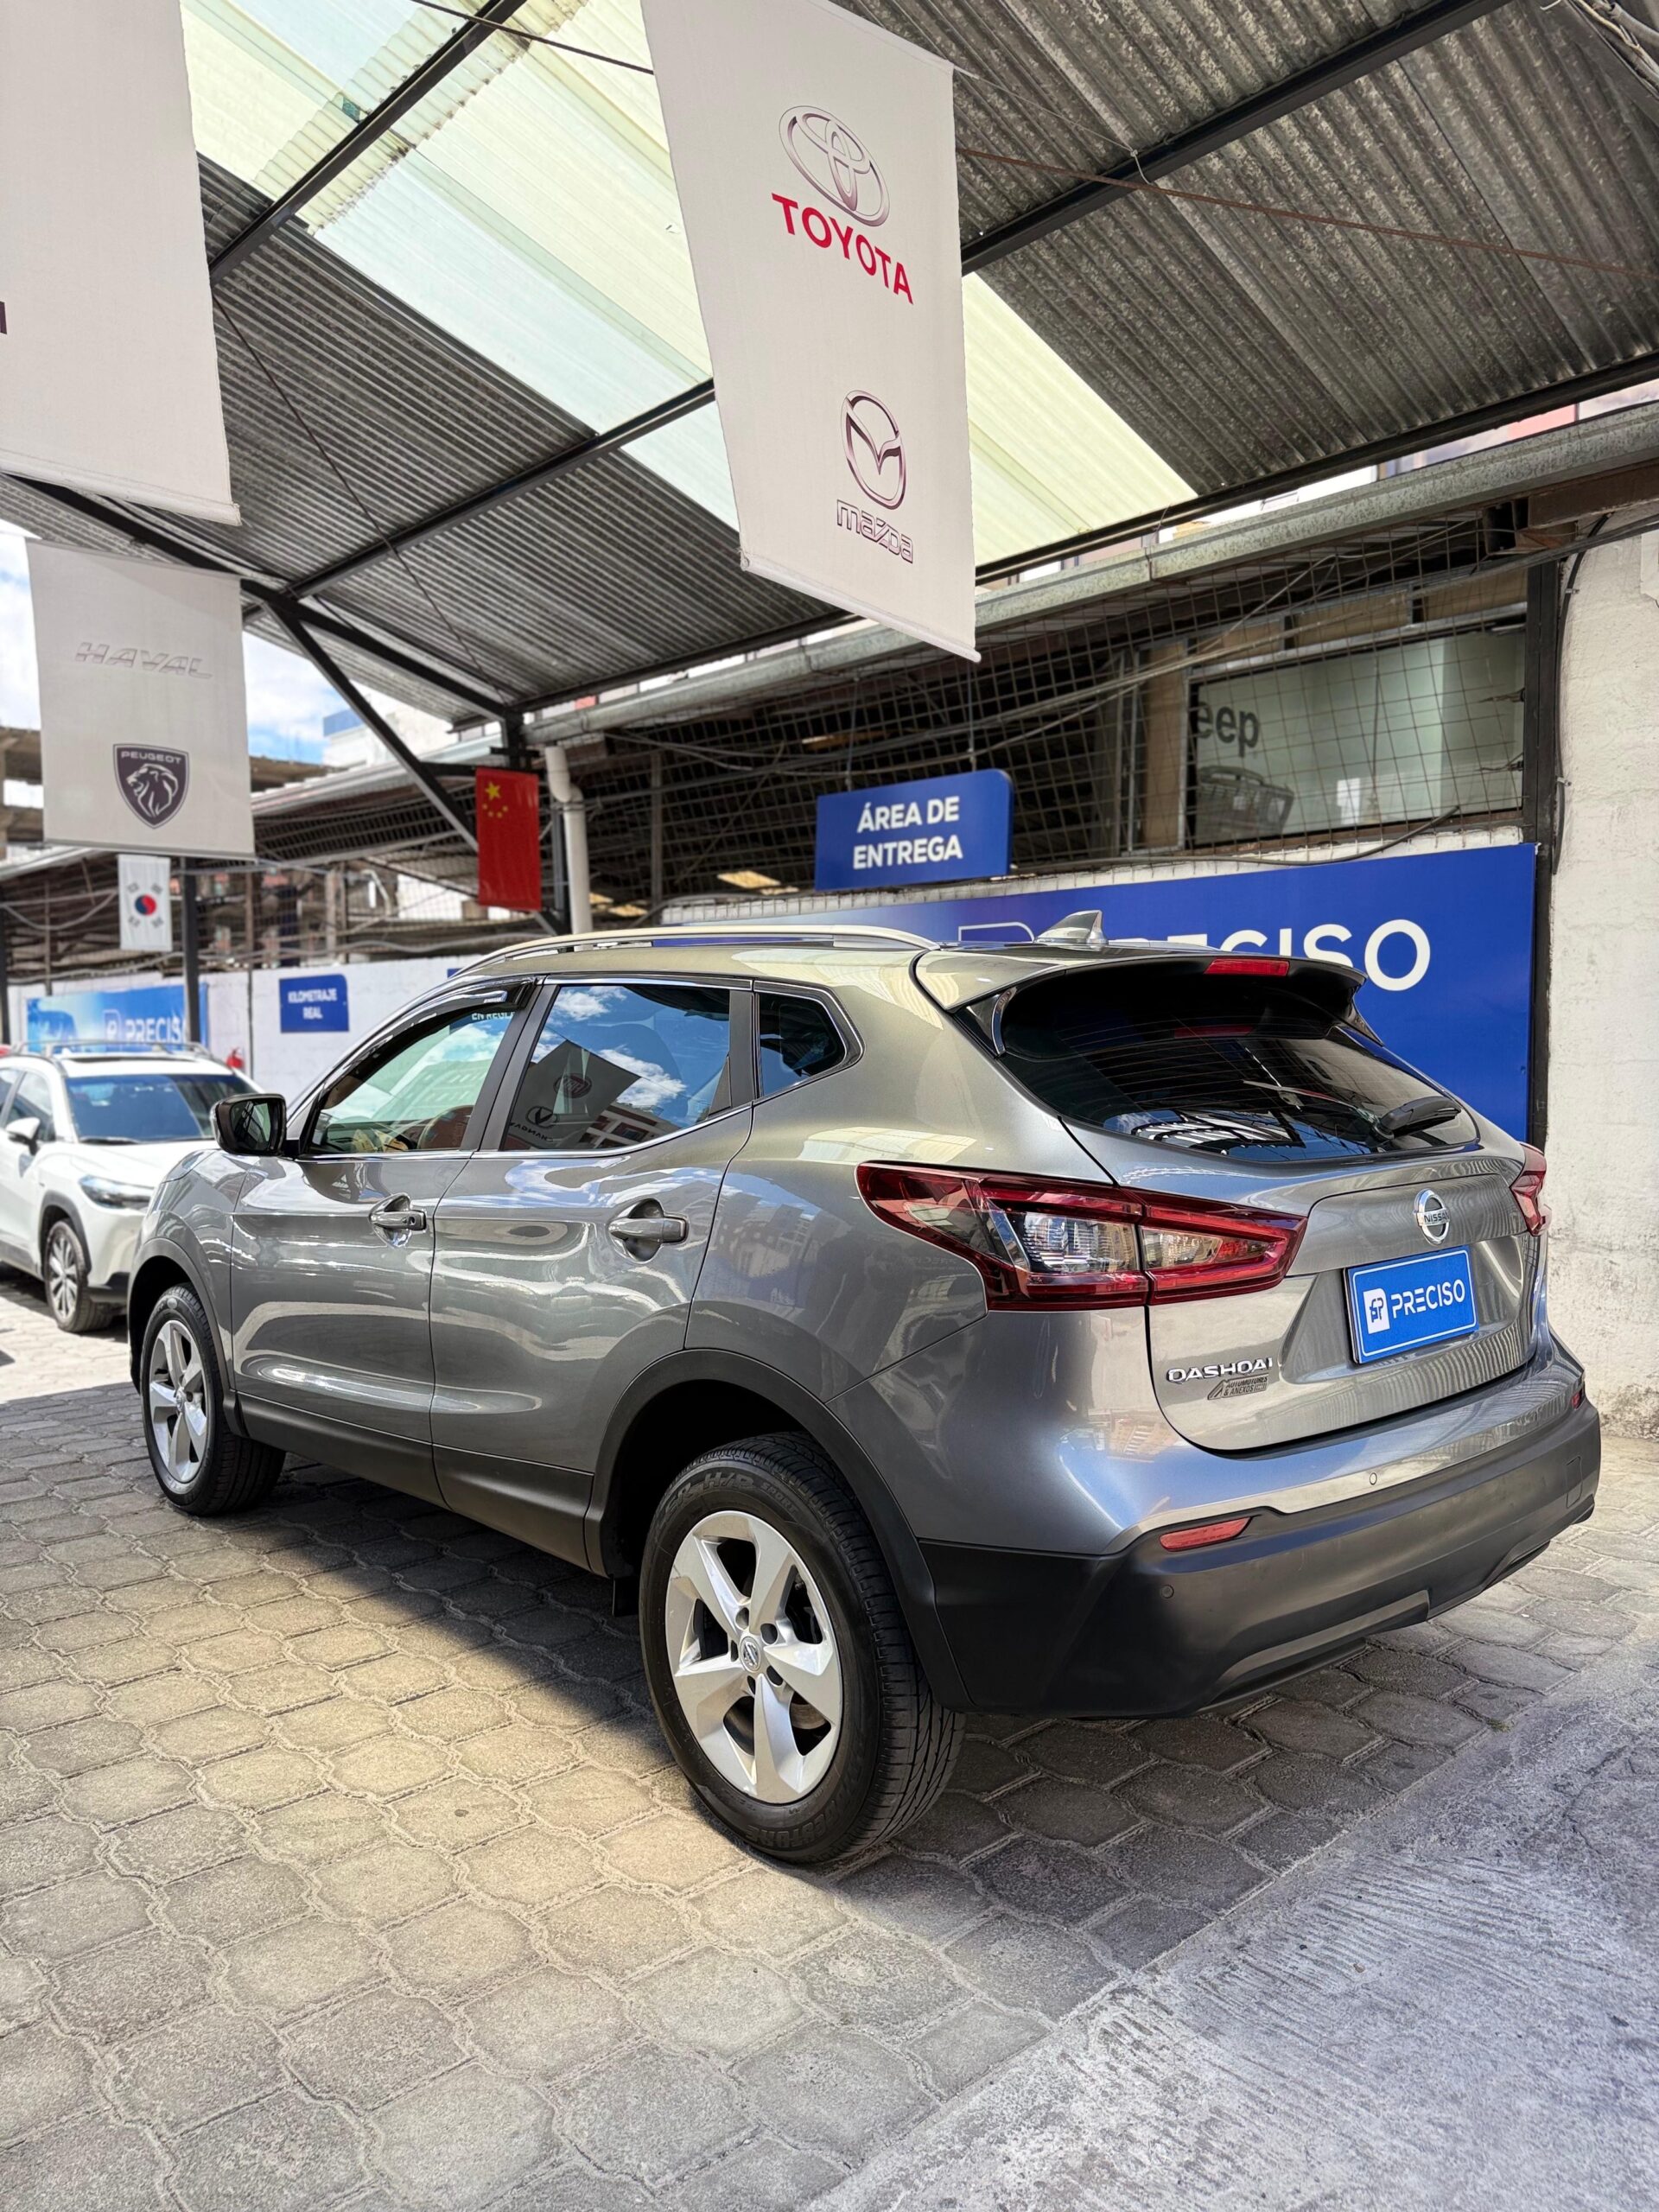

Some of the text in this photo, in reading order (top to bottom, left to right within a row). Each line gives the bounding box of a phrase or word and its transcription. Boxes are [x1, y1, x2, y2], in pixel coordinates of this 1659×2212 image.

[771, 193, 914, 305] TOYOTA
[836, 499, 913, 565] mazda
[74, 641, 214, 679] HAVAL
[1196, 702, 1261, 759] eep
[120, 750, 182, 765] PEUGEOT
[856, 795, 960, 834] ÁREA DE
[852, 834, 963, 870] ENTREGA
[124, 1016, 186, 1043] PRECIS
[1423, 1209, 1451, 1224] NISSAN
[1390, 1278, 1466, 1319] PRECISO
[1166, 1357, 1273, 1384] QASHQAI
[1230, 1384, 1255, 1395] ANEXOS
